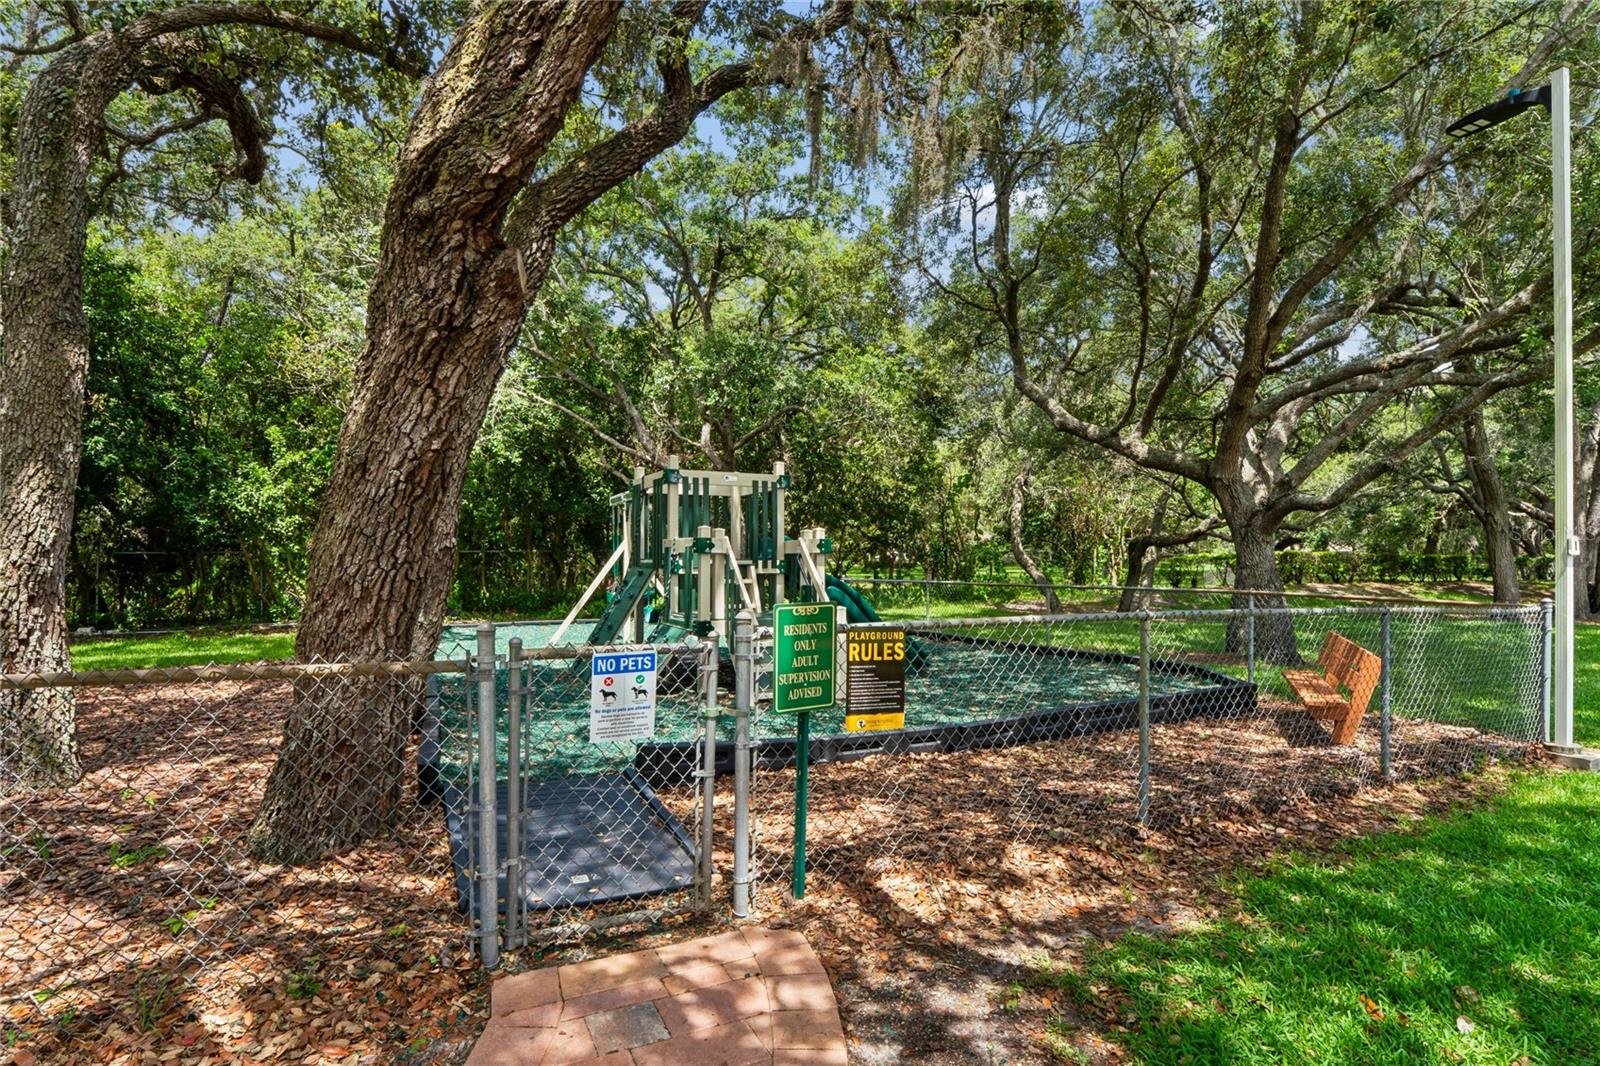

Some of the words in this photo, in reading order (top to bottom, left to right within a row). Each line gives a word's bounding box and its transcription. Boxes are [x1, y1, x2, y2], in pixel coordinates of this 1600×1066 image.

[784, 623, 827, 636] RESIDENTS
[849, 631, 905, 640] PLAYGROUND
[794, 640, 817, 651] ONLY
[849, 642, 905, 662] RULES
[597, 658, 616, 672] NO
[620, 656, 652, 671] PETS
[792, 655, 819, 668] ADULT
[779, 670, 830, 685] SUPERVISION
[788, 687, 822, 700] ADVISED
